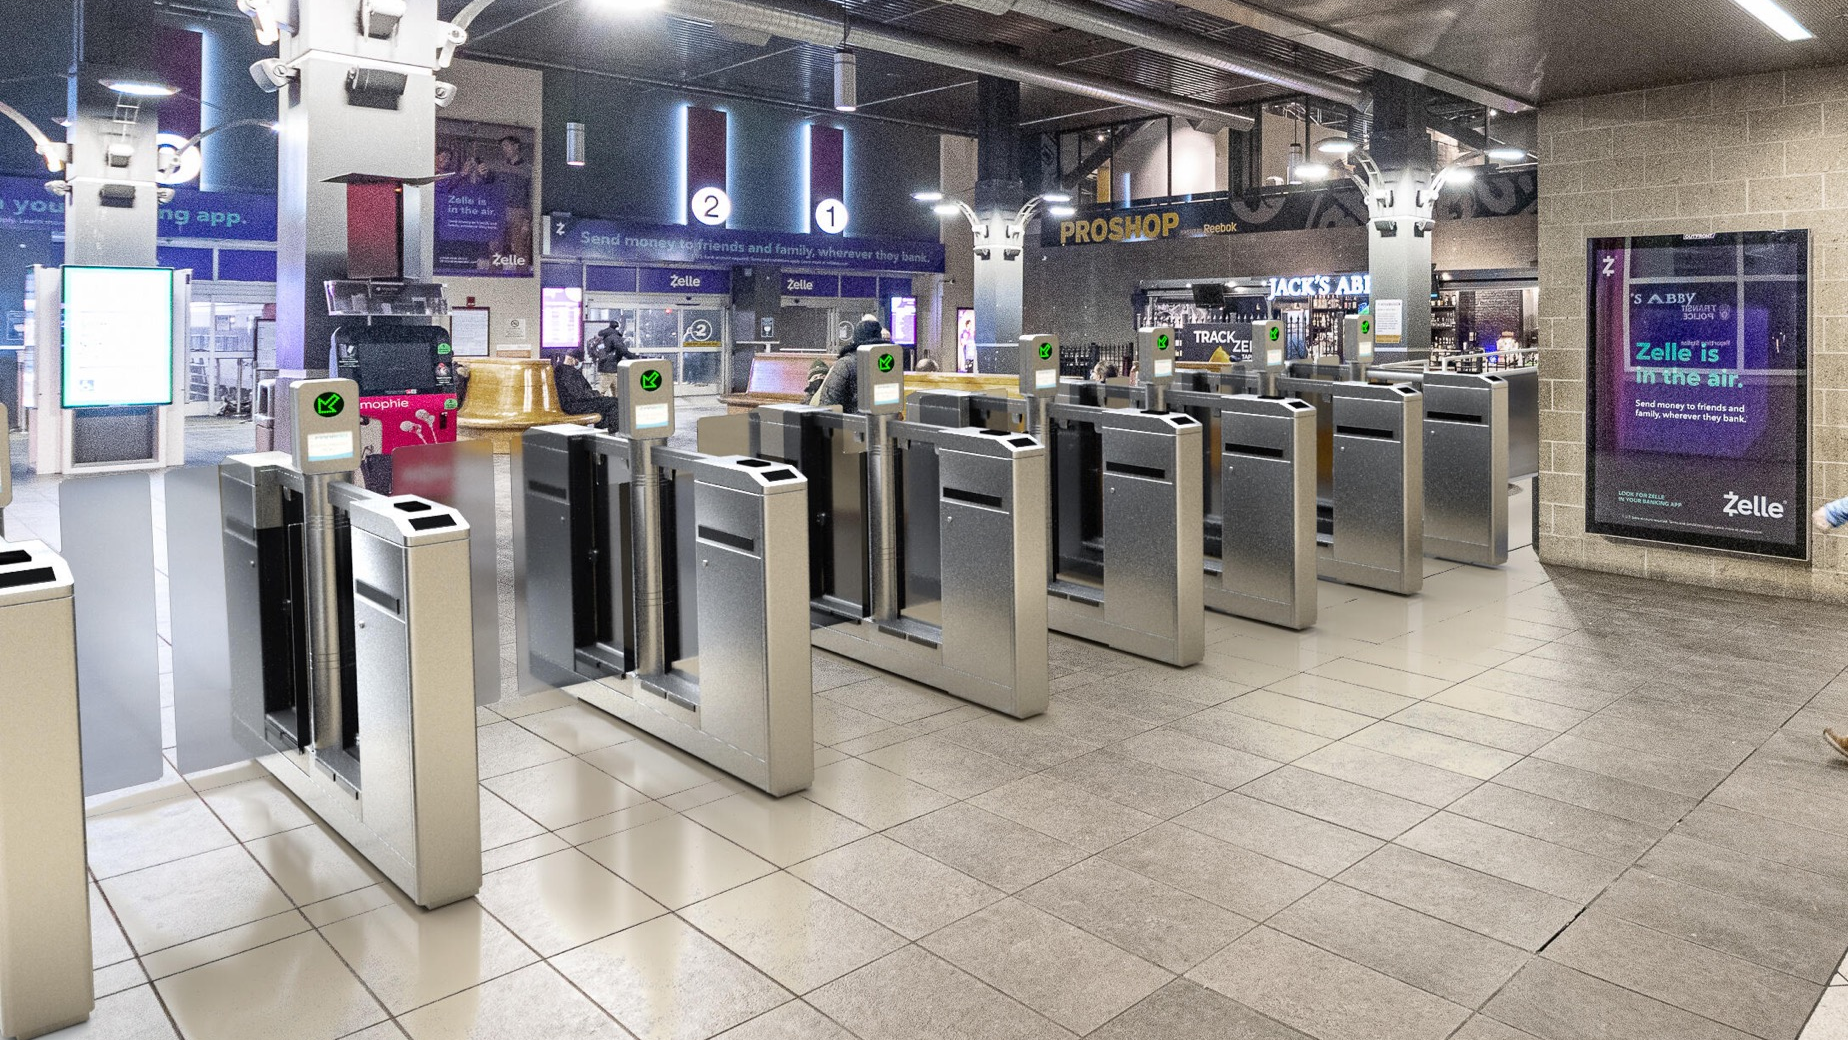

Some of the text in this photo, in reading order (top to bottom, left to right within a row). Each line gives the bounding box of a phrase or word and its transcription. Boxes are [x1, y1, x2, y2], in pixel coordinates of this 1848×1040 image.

[447, 195, 487, 206] Zelle is
[704, 194, 719, 218] 2
[12, 199, 66, 216] you
[196, 208, 248, 227] app.
[448, 205, 458, 214] in
[461, 206, 479, 215] the
[826, 206, 835, 227] 1
[1060, 212, 1237, 244] PROSHOP Reebok
[580, 230, 621, 247] Send
[624, 236, 677, 250] money
[679, 237, 695, 251] to
[697, 238, 745, 253] friends
[747, 242, 772, 254] and
[775, 244, 816, 259] family,
[818, 246, 873, 260] wherever
[876, 249, 899, 264] they
[901, 251, 930, 263] bank.
[492, 253, 526, 267] Zelle
[670, 274, 701, 288] Zelle
[787, 278, 814, 291] Zelle
[1267, 274, 1332, 300] JACK'S
[1647, 291, 1697, 305] ABBY
[695, 324, 707, 337] 2
[1193, 330, 1236, 344] TRACK
[1635, 342, 1720, 362] Zelle is
[1635, 366, 1743, 388] in the air.
[360, 398, 409, 411] mophie
[1635, 399, 1656, 408] Send
[1657, 402, 1685, 411] money
[1697, 402, 1727, 412] friends
[1728, 405, 1745, 413] and
[1635, 409, 1747, 423] family, wherever they bank.
[1643, 499, 1670, 507] BANKING
[1648, 493, 1665, 501] ZELLE
[1722, 491, 1784, 519] Zelle
